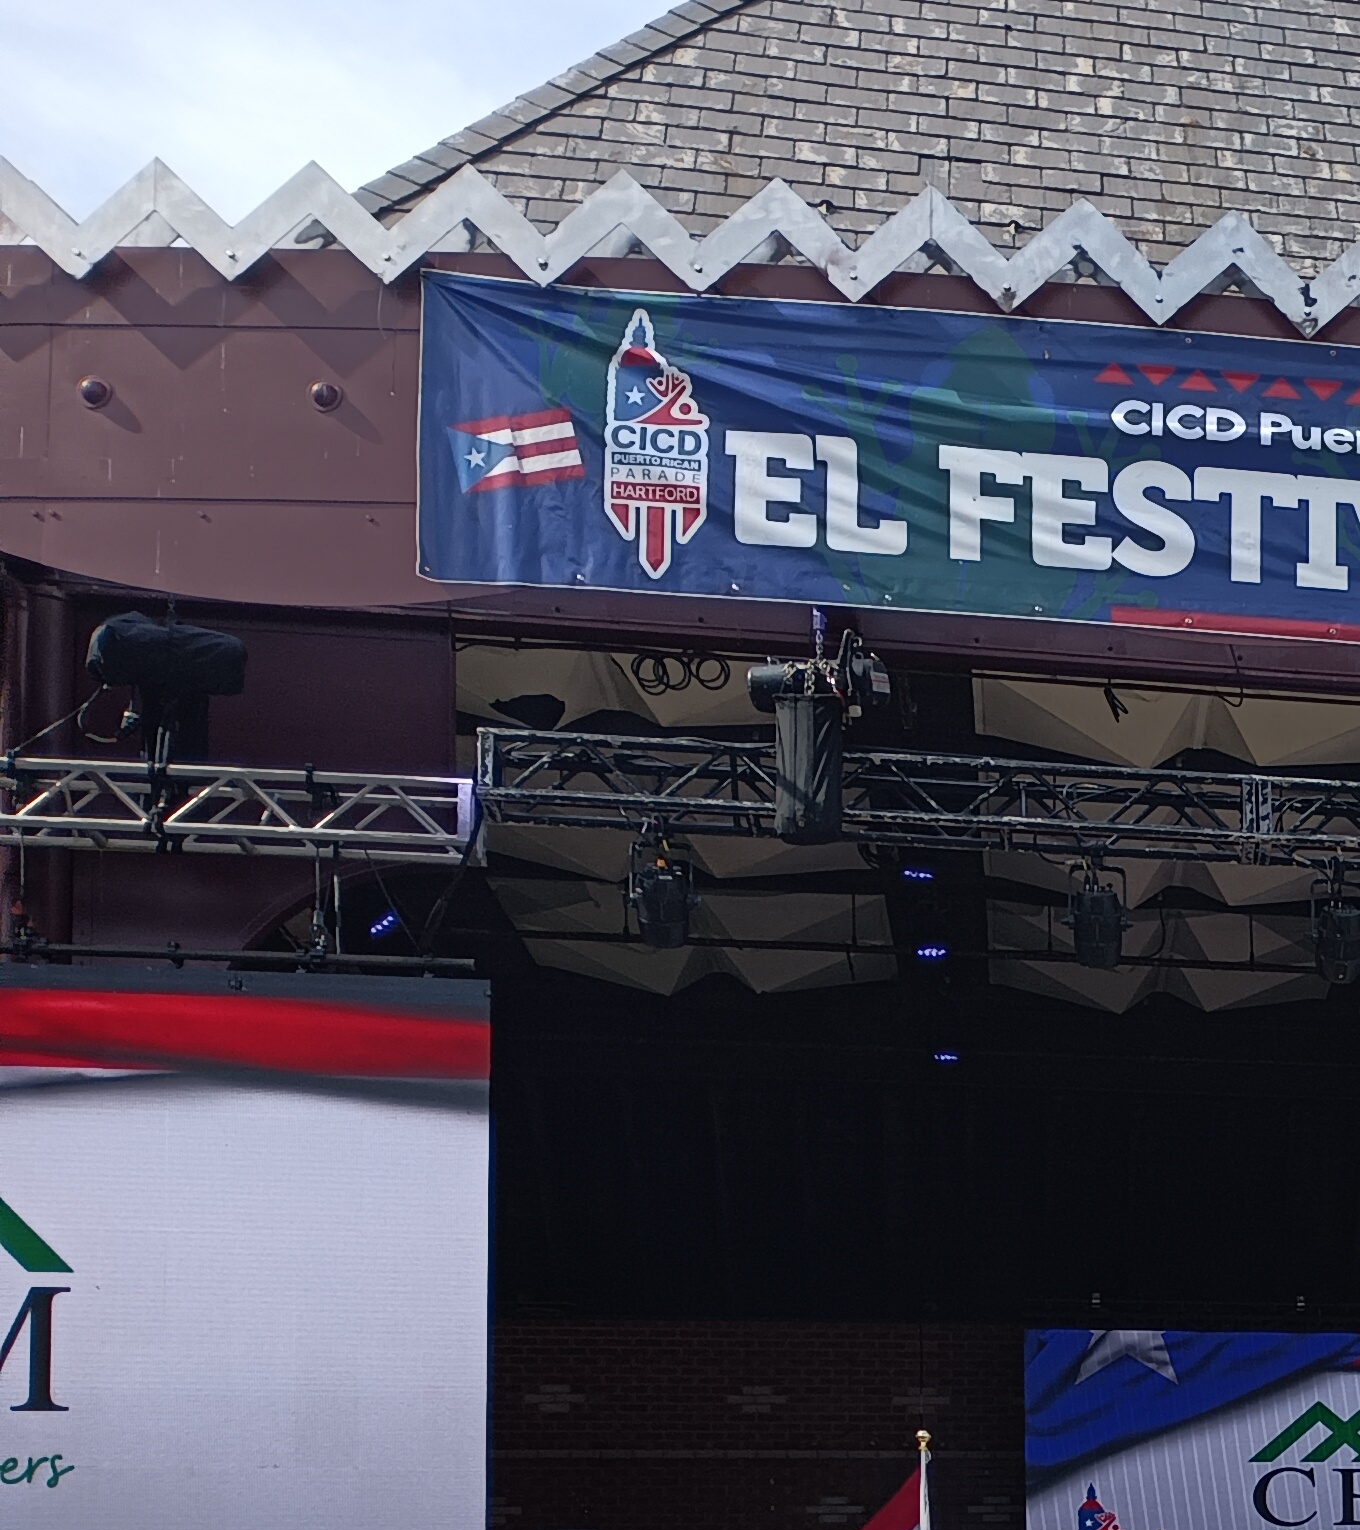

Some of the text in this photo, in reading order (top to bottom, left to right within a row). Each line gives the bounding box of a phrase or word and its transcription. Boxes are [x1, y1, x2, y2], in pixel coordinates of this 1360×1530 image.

[1111, 399, 1246, 441] CICD
[611, 424, 701, 455] CICD
[614, 454, 699, 470] PUERTO RICAN
[611, 467, 700, 484] PARADE
[612, 483, 698, 501] HARTFORD
[725, 430, 908, 555] EL
